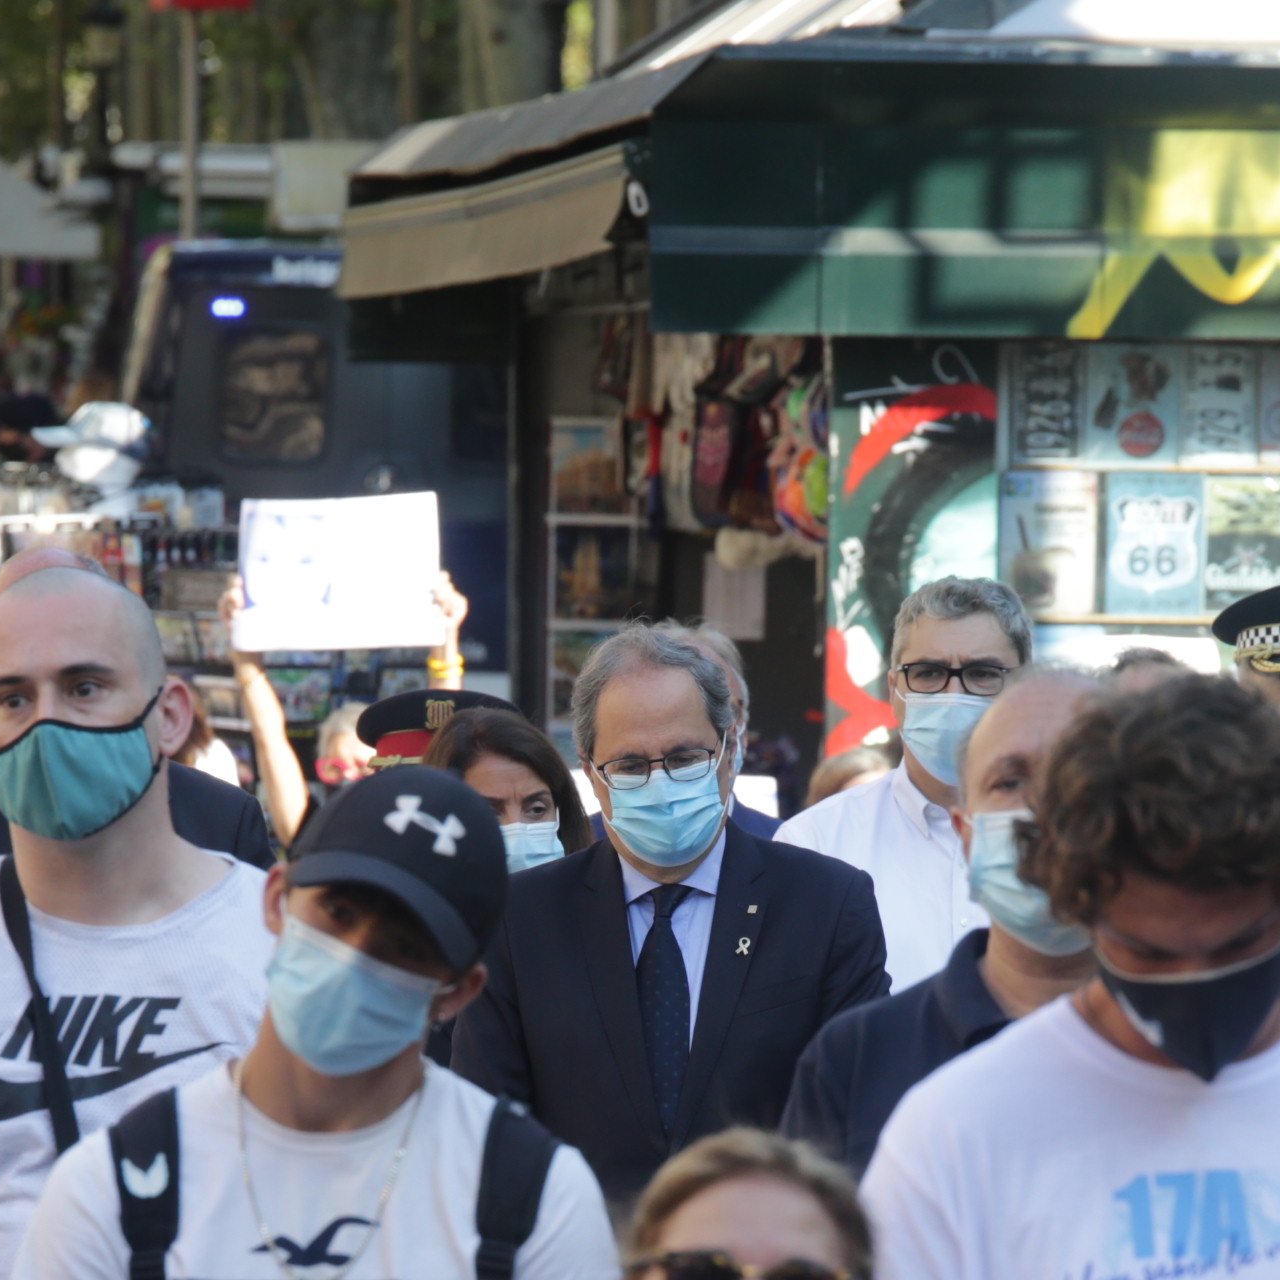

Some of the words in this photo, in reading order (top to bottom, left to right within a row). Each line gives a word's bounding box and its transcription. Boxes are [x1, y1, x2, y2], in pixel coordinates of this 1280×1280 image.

[1128, 545, 1177, 577] 66
[0, 994, 182, 1068] NIKE
[1111, 1168, 1255, 1261] 17A
